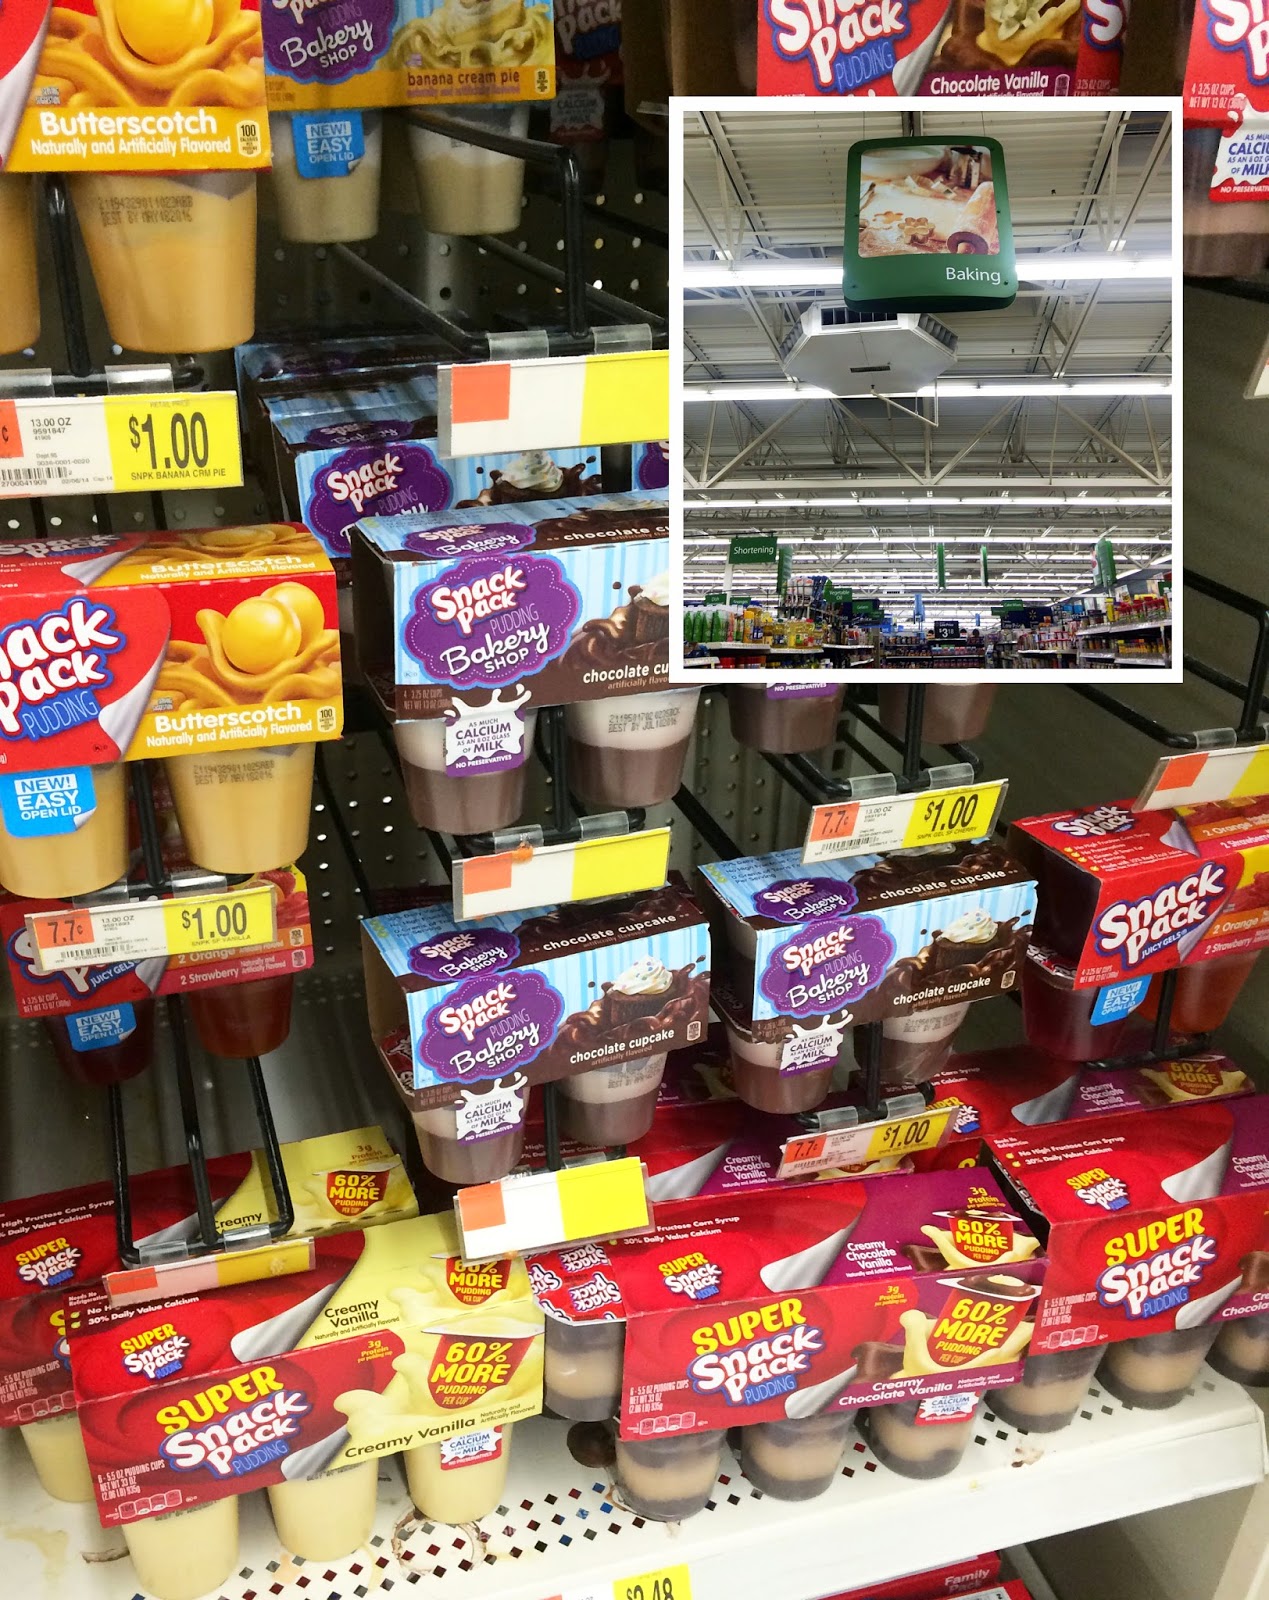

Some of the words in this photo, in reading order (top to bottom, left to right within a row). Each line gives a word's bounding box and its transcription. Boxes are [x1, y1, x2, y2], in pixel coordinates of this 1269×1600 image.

[280, 20, 373, 67] Bakery
[320, 45, 357, 68] SHOP
[835, 42, 893, 88] PUDDING
[408, 71, 453, 86] banana
[458, 70, 496, 85] cream
[501, 69, 519, 84] pie
[930, 75, 1000, 95] Chocolate
[1004, 71, 1049, 90] Vanilla
[1220, 84, 1235, 95] CUPS
[1189, 97, 1200, 108] NET
[1201, 96, 1210, 108] WT
[39, 110, 217, 136] Butterscotch
[311, 124, 347, 136] NEW!
[30, 141, 87, 156] Naturally
[92, 139, 113, 154] and
[119, 138, 177, 156] Artificially
[180, 137, 231, 153] Flavored
[308, 138, 352, 154] EASY
[309, 153, 338, 163] OPEN
[946, 266, 1000, 285] Baking
[30, 418, 55, 427] 13.00
[58, 417, 72, 426] OZ
[129, 411, 209, 469] $1.00
[131, 472, 153, 480] SNPK
[156, 470, 191, 479] BANANA
[193, 469, 211, 478] CRM
[213, 468, 226, 476] PIE
[326, 454, 404, 502] Snack
[349, 475, 398, 513] Pack
[564, 526, 649, 542] chocolate
[437, 534, 520, 554] Bakery
[733, 546, 774, 556] Shortening
[140, 571, 186, 580] Naturally
[189, 568, 206, 577] and
[218, 565, 267, 576] Artificially
[271, 562, 316, 571] Flavored
[150, 555, 301, 573] Butterscotch
[431, 565, 526, 620] Snack
[829, 589, 850, 597] Vegetable
[456, 592, 517, 634] Pack
[490, 603, 539, 636] PUDDING
[440, 623, 550, 675] Bakery
[485, 648, 529, 673] SHOP
[583, 665, 649, 684] chocolate
[608, 678, 647, 689] artificially
[786, 682, 827, 691] PRESERVATIVES
[22, 690, 98, 739] PUDDING
[155, 702, 301, 733] Butterscotch
[320, 708, 332, 719] 100
[146, 731, 193, 747] Naturally
[196, 730, 216, 743] and
[219, 724, 269, 743] Artificially
[270, 720, 312, 736] Flavored
[456, 722, 511, 740] CALCIUM
[474, 740, 503, 753] MILK
[468, 755, 512, 766] PRESERVATIVES
[21, 775, 72, 792] NEW!
[18, 791, 79, 810] EASY
[21, 807, 59, 821] OPEN
[60, 805, 81, 817] LID
[925, 794, 979, 832] $1.00
[1054, 806, 1129, 836] Snack
[954, 827, 977, 835] CHERRY
[1211, 822, 1252, 834] Orange
[763, 881, 815, 903] Snack
[880, 879, 947, 900] chocolate
[950, 869, 1006, 888] cupcake
[783, 888, 814, 905] Pack
[784, 894, 848, 920] Bakery
[1100, 865, 1224, 949] Snack
[182, 902, 246, 940] $1.00
[1213, 924, 1219, 934] 2
[1222, 917, 1258, 931] Orange
[543, 929, 615, 951] chocolate
[618, 914, 677, 935] cupcake
[1127, 901, 1207, 964] Pack
[420, 933, 475, 958] Snack
[783, 925, 855, 970] Snack
[1141, 942, 1163, 959] JUICY
[1163, 932, 1182, 948] GELS
[1212, 937, 1252, 953] Strawberry
[439, 947, 508, 977] Bakery
[470, 958, 498, 973] SHOP
[90, 970, 113, 987] JUICY
[114, 961, 135, 974] GELS
[180, 976, 187, 985] 2
[189, 968, 239, 983] Strawberry
[786, 961, 870, 1008] Bakery
[893, 984, 944, 1005] chocolate
[948, 976, 991, 995] cupcake
[1109, 982, 1139, 998] NEW!
[439, 982, 517, 1034] Snack
[1103, 991, 1141, 1009] EASY
[81, 1012, 116, 1025] NEW!
[1101, 1005, 1124, 1017] OPEN
[79, 1019, 121, 1036] EASY
[81, 1032, 107, 1042] OPEN
[108, 1028, 124, 1036] LID
[449, 1021, 540, 1075] Bakery
[569, 1042, 626, 1065] chocolate
[628, 1028, 675, 1051] cupcake
[790, 1035, 832, 1052] CALCIUM
[802, 1049, 825, 1059] MILK
[1171, 1071, 1219, 1084] MORE
[465, 1101, 512, 1120] CALCIUM
[480, 1115, 505, 1128] MILK
[883, 1120, 930, 1148] $1.00
[1026, 1146, 1051, 1156] High
[1052, 1142, 1082, 1153] Fructose
[1084, 1139, 1101, 1147] Corn
[1103, 1135, 1125, 1145] Syrup
[725, 1154, 761, 1165] Creamy
[1044, 1156, 1062, 1165] Daily
[1063, 1152, 1084, 1161] Value
[1085, 1147, 1112, 1156] Calcium
[723, 1160, 771, 1173] Chocolate
[733, 1168, 767, 1180] Vanilla
[333, 1175, 376, 1188] 60%
[957, 1220, 1001, 1235] 60%
[1104, 1207, 1205, 1267] SUPER
[955, 1233, 1008, 1249] MORE
[964, 1245, 999, 1255] PUDDING
[15, 1237, 70, 1265] SUPER
[1100, 1236, 1216, 1304] Snack
[1127, 1264, 1201, 1316] Pack
[324, 1300, 379, 1318] Creamy
[951, 1298, 1014, 1325] 60%
[330, 1310, 379, 1328] Vanilla
[691, 1298, 807, 1356] SUPER
[933, 1321, 1008, 1347] MORE
[445, 1342, 513, 1363] 60%
[430, 1363, 511, 1384] MORE
[838, 1390, 906, 1406] Chocolate
[909, 1382, 953, 1396] Vanilla
[872, 1378, 924, 1392] Creamy
[155, 1366, 284, 1435] SUPER
[166, 1392, 308, 1467] Snack
[344, 1433, 414, 1458] Creamy
[418, 1417, 475, 1439] Vanilla
[945, 1569, 990, 1586] Family
